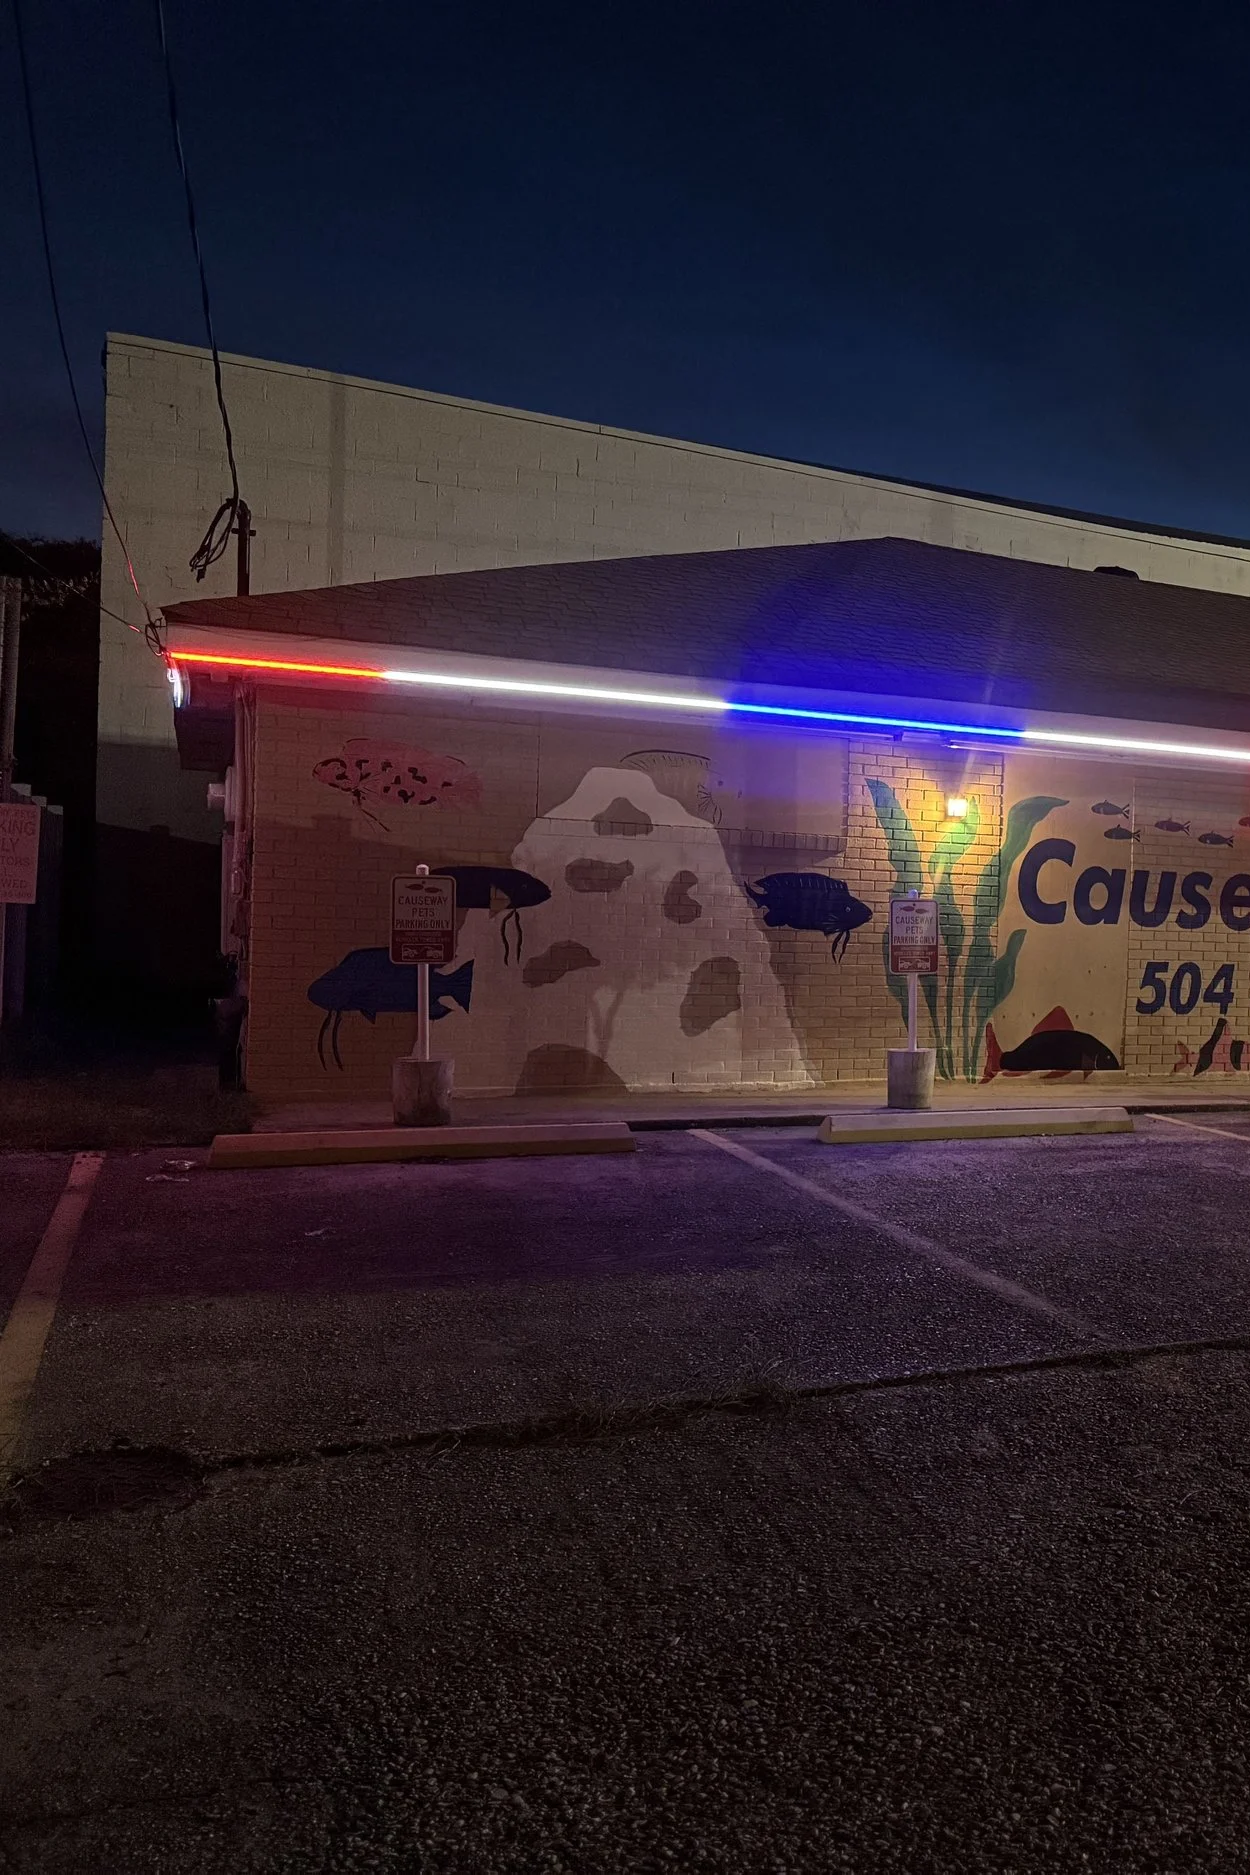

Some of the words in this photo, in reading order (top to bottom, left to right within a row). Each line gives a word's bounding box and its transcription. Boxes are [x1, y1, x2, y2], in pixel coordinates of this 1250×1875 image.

[398, 896, 449, 906] CAUSEWAY
[411, 907, 435, 918] PETS
[395, 919, 428, 929] PARKING
[430, 919, 449, 929] ONLY
[895, 916, 934, 925] CAUSEWAY
[905, 926, 924, 935] PETS
[893, 935, 919, 945] PARKING
[919, 935, 936, 944] ONLY
[1136, 961, 1236, 1016] 504
